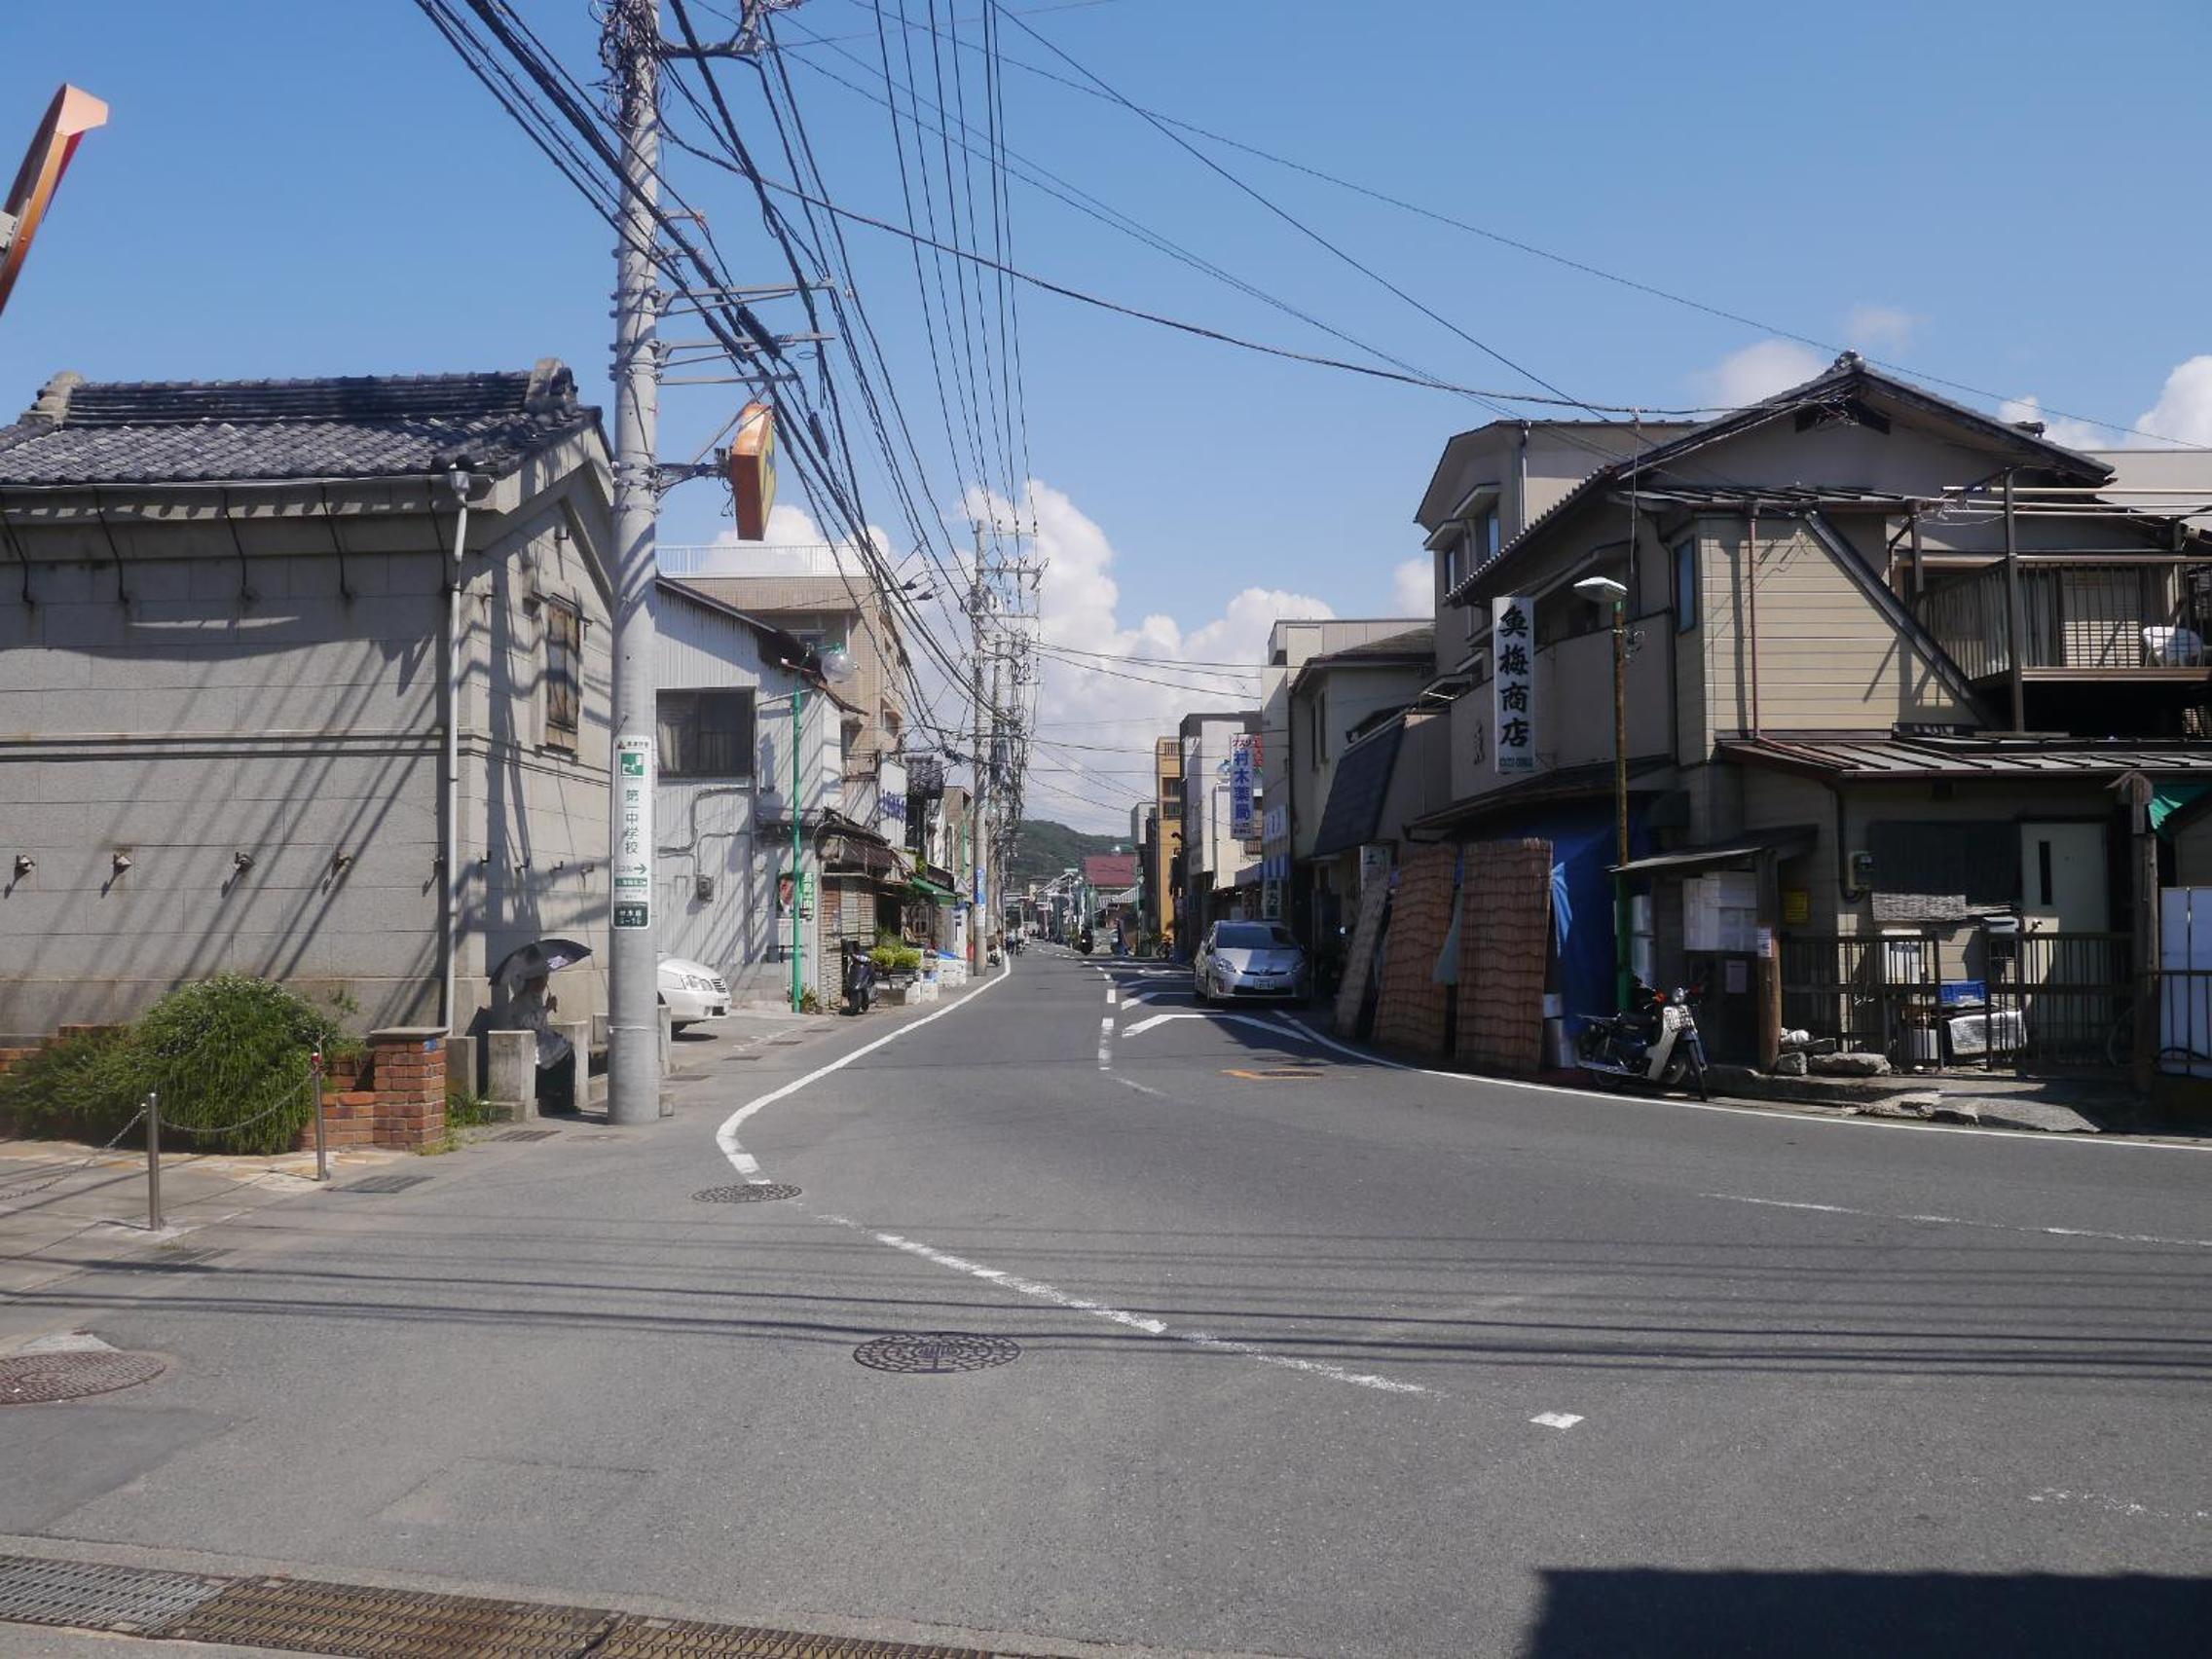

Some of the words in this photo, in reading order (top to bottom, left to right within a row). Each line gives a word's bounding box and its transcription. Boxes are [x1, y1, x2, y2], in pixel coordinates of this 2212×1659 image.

[1499, 605, 1530, 748] 魚梅商店
[624, 790, 639, 855] 第一中学校
